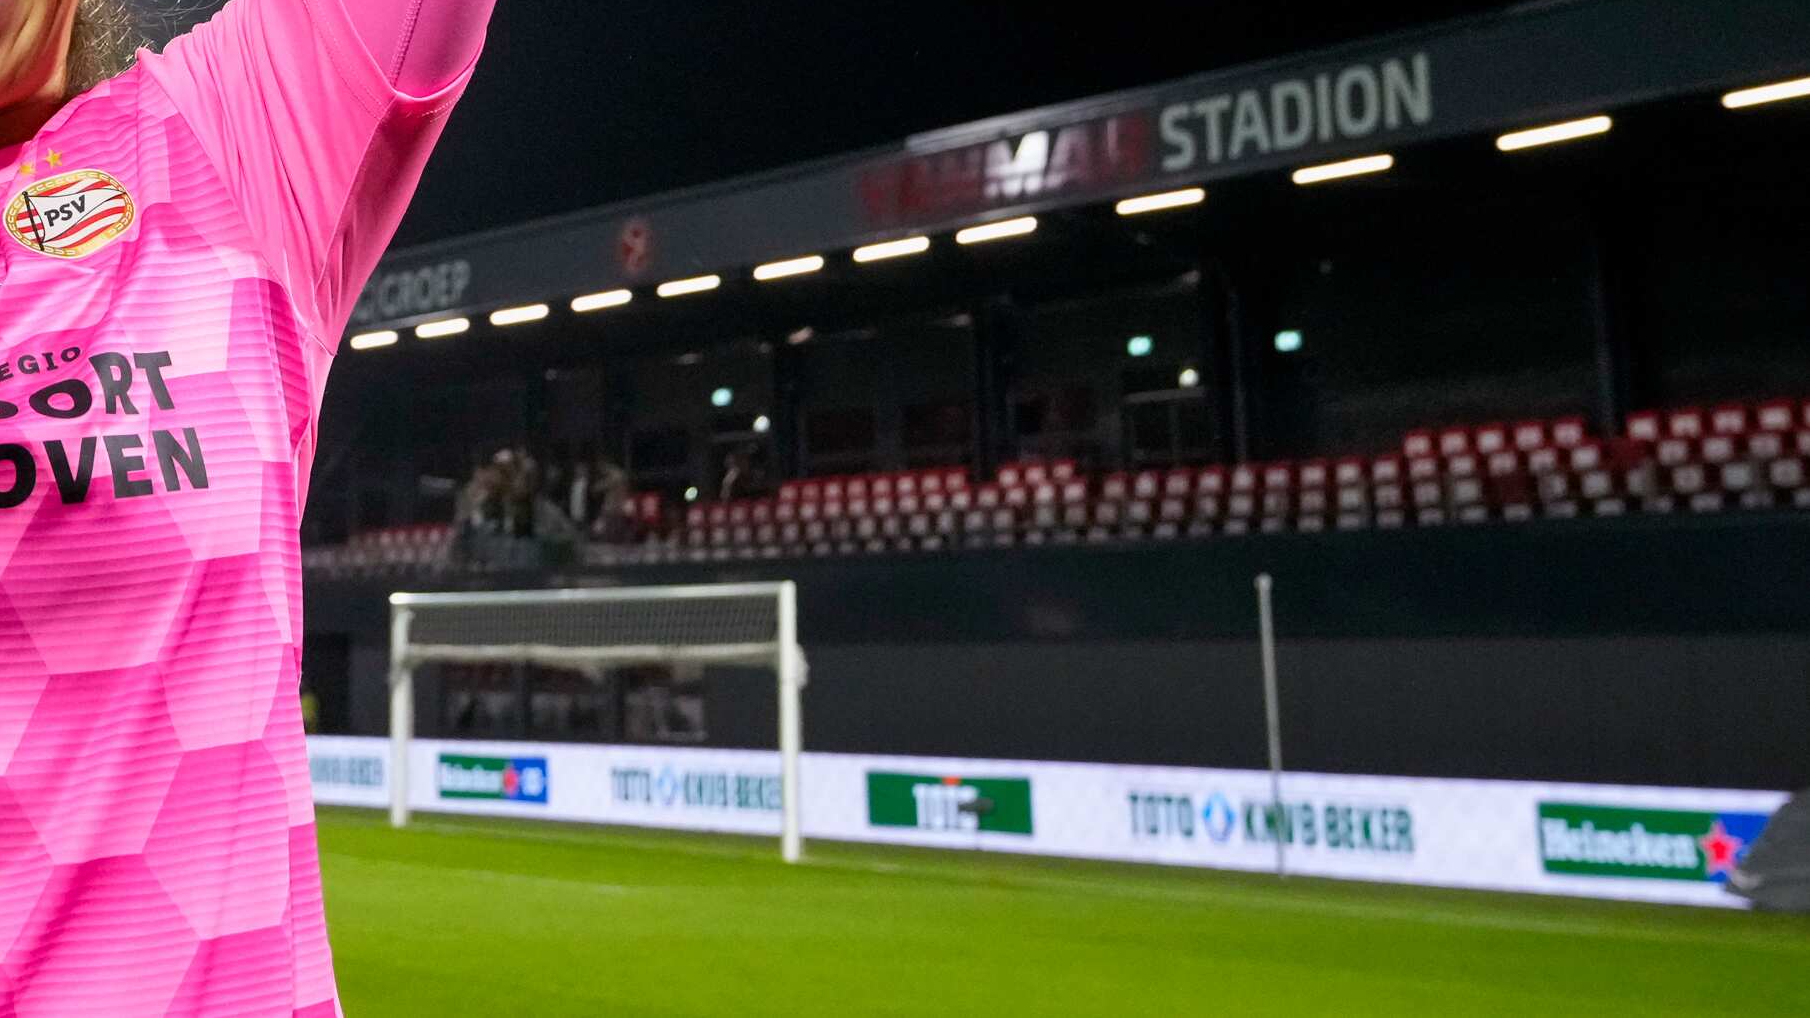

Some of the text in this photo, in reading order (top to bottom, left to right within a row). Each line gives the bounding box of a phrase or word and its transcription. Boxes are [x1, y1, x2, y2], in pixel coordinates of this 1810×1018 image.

[1159, 52, 1431, 172] STADION
[44, 194, 86, 227] PSV
[1129, 794, 1194, 838] TOTO
[1323, 803, 1415, 853] BEKER
[1541, 816, 1700, 870] Heineken
